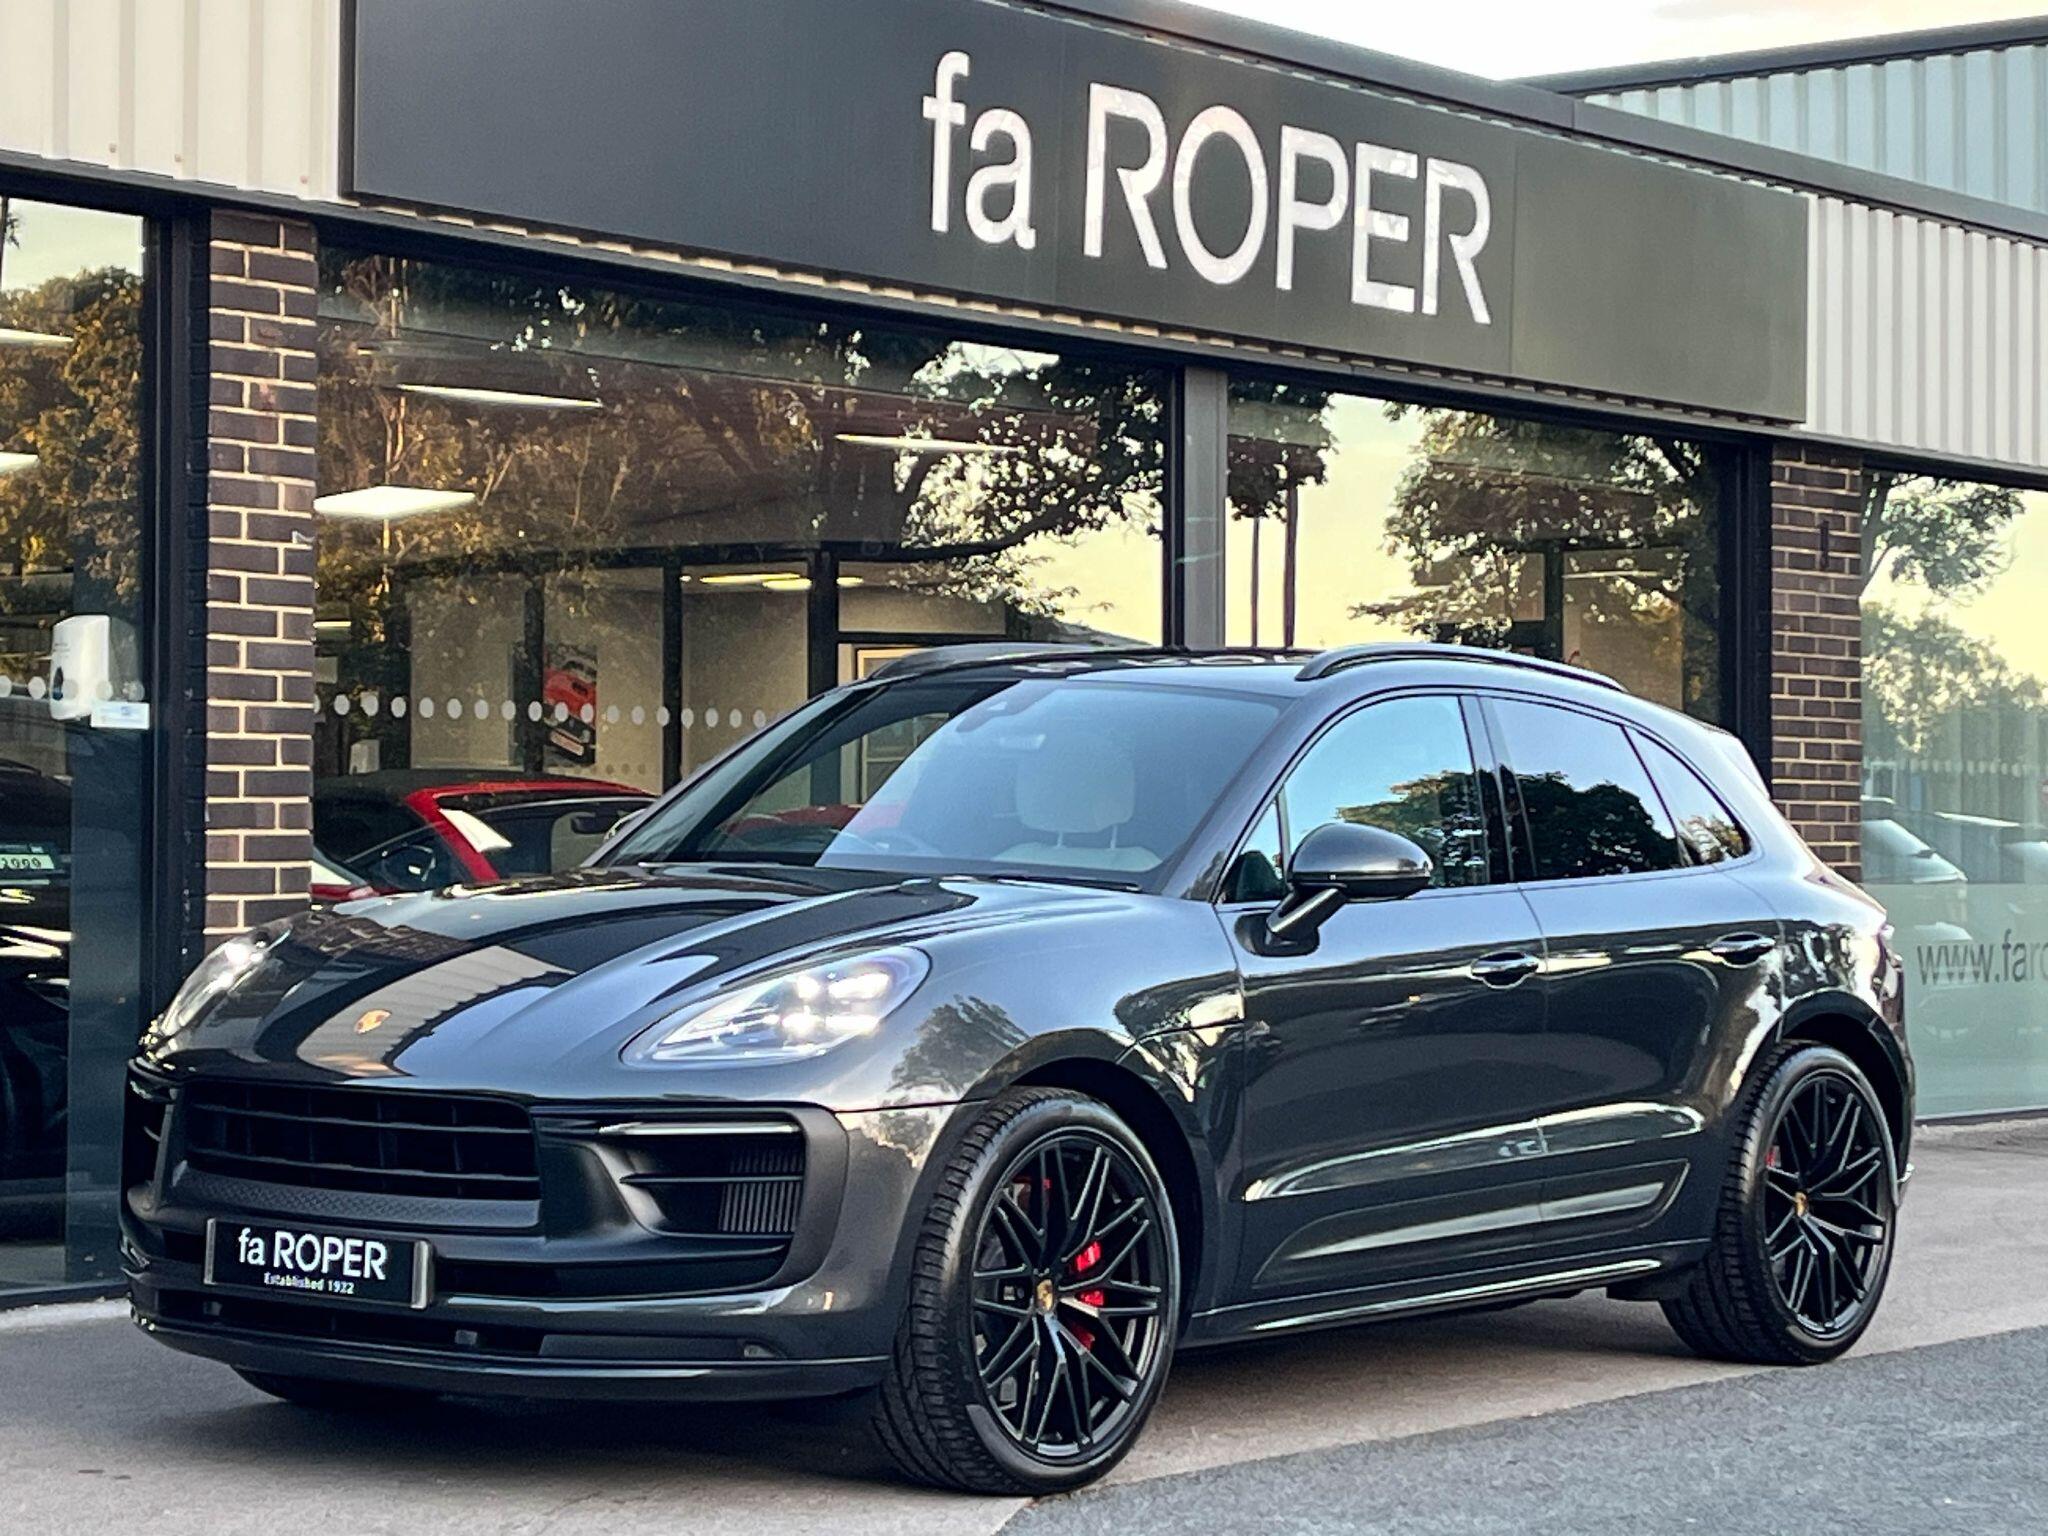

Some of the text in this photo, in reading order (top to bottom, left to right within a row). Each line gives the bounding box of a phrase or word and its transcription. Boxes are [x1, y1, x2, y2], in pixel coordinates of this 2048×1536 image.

[922, 50, 1491, 325] fa ROPER
[238, 1228, 388, 1280] fa ROPER
[264, 1272, 325, 1292] Established
